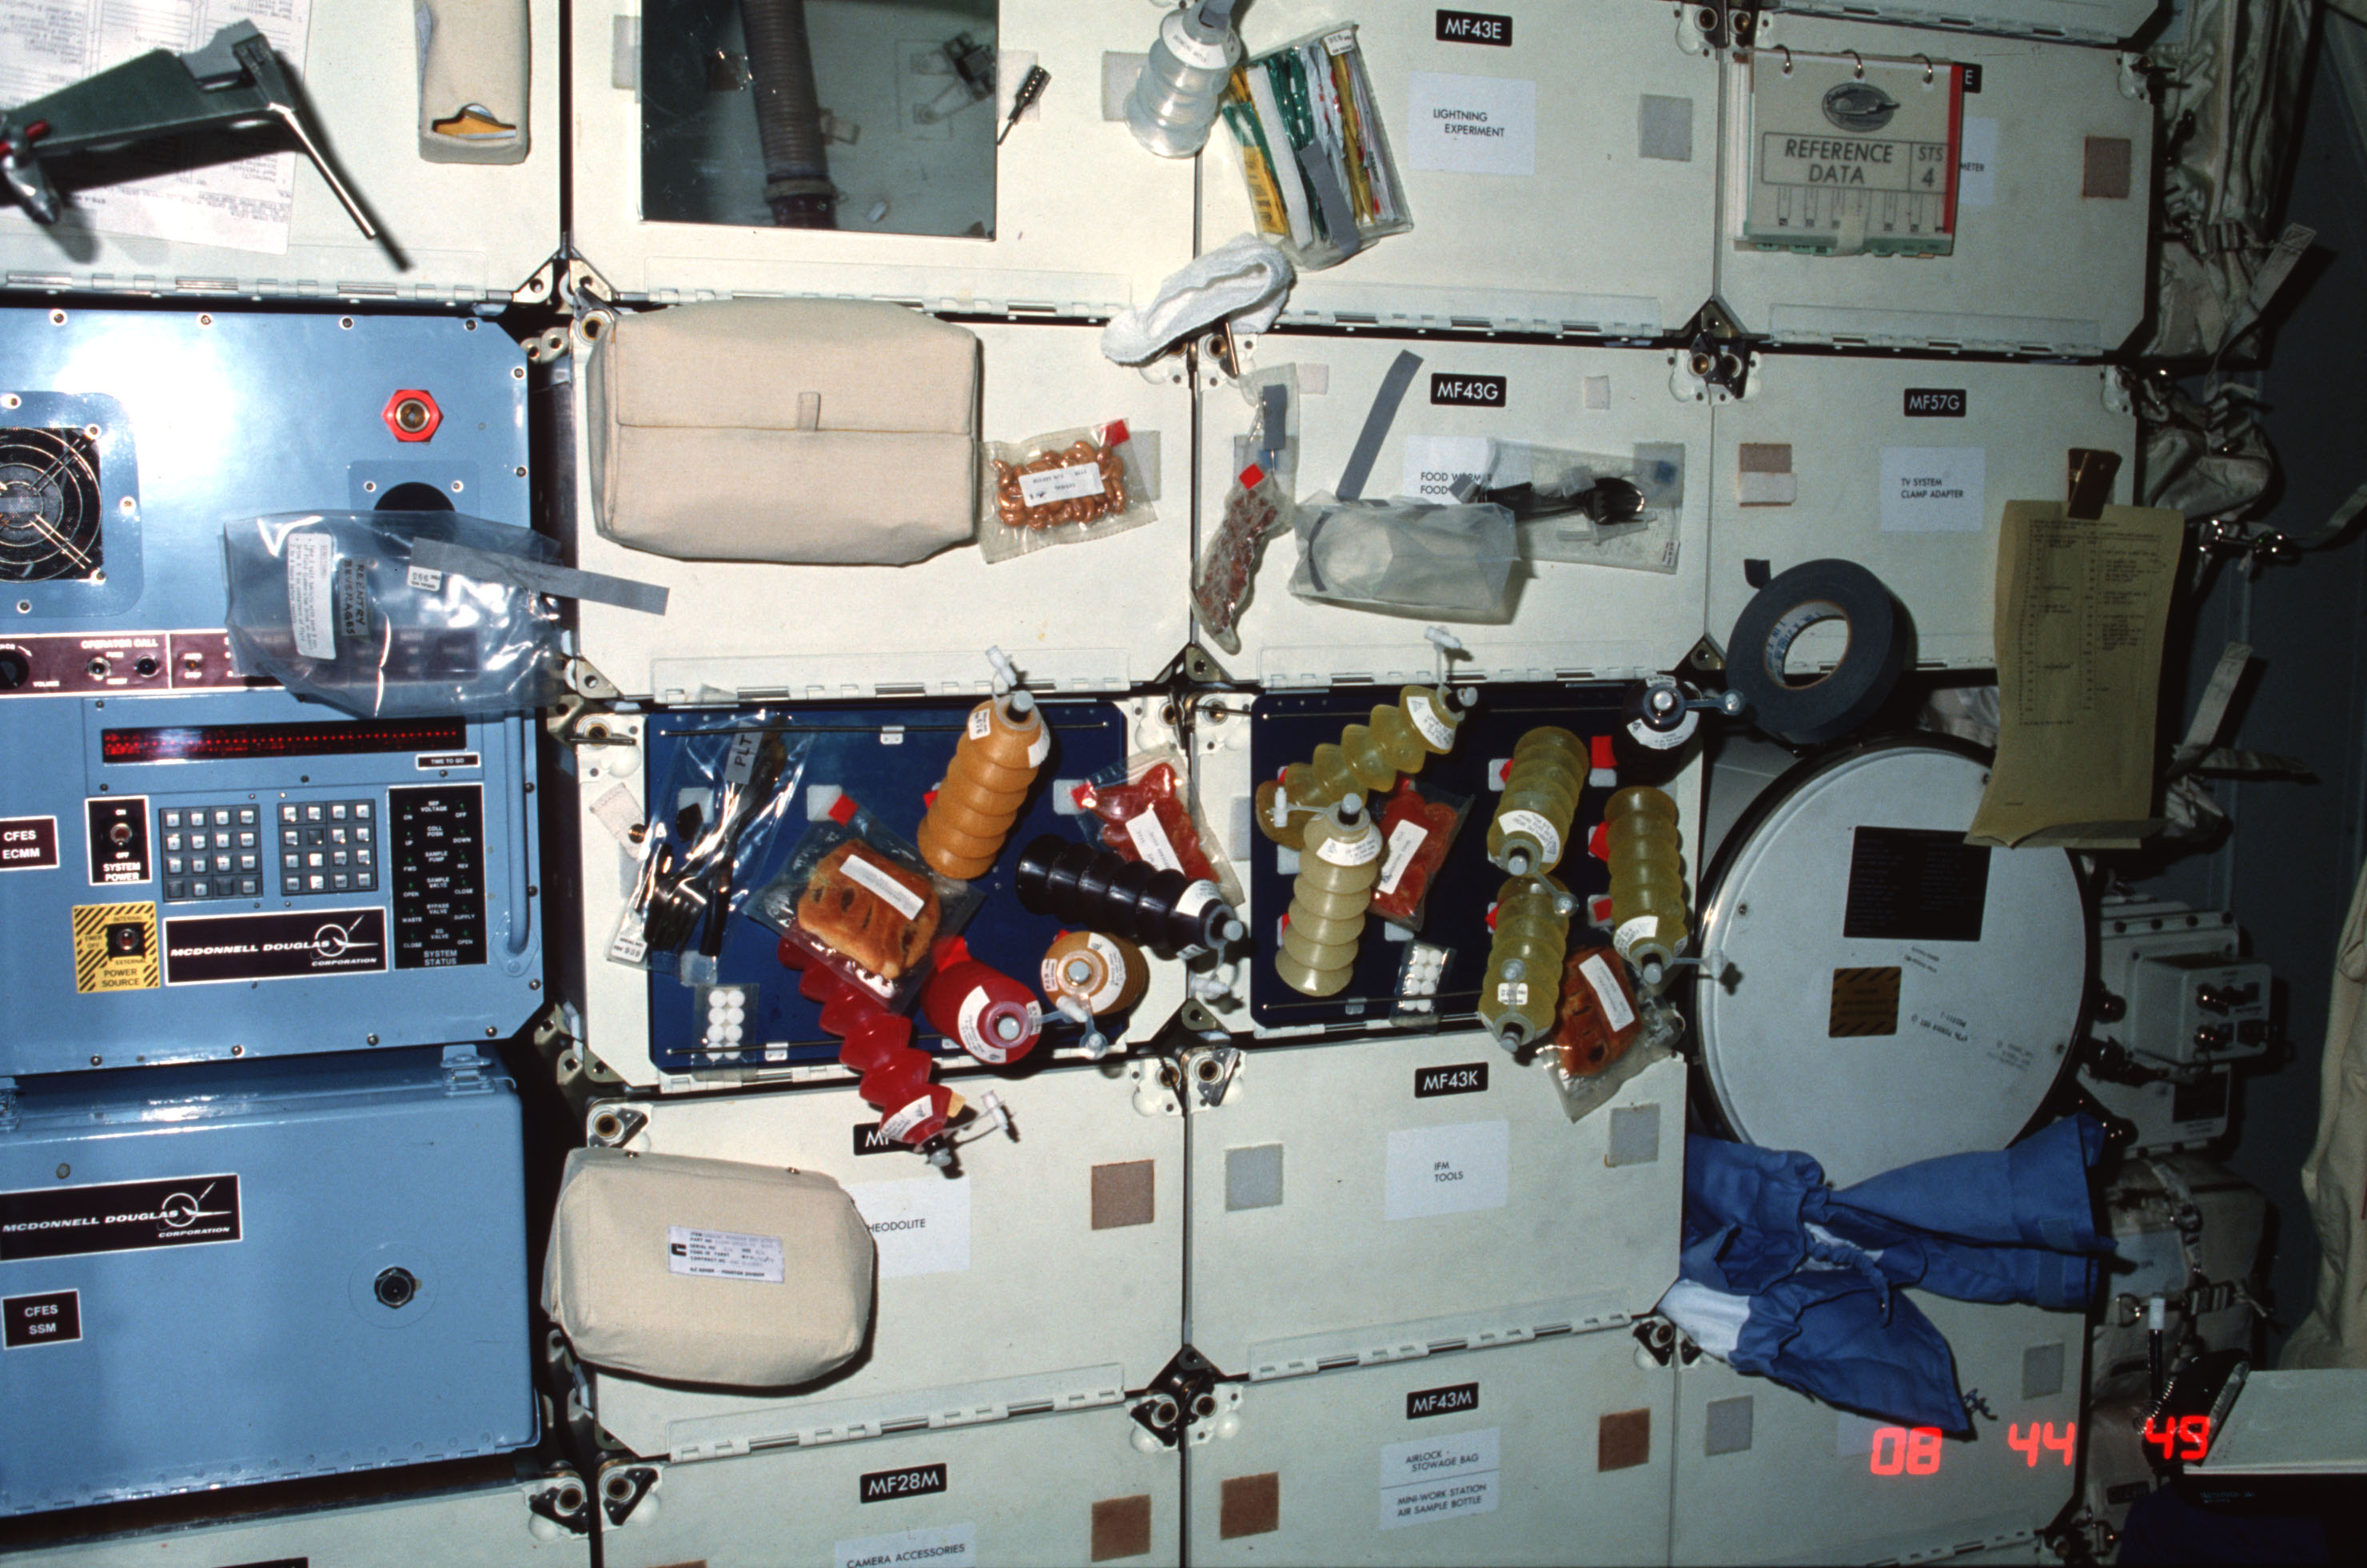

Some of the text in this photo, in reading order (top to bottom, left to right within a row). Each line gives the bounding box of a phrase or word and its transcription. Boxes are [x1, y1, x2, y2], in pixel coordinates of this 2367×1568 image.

[1445, 18, 1502, 40] MF43E
[1433, 108, 1488, 122] LIGHTNING
[1445, 123, 1505, 137] EXPERIMENT
[1784, 138, 1894, 164] REFERENCE
[1918, 145, 1944, 161] STS
[1807, 164, 1865, 185] DATA
[1959, 162, 1985, 173] METER
[1922, 166, 1935, 187] 4
[1437, 380, 1500, 400] MF43G
[1908, 394, 1960, 411] MF57G
[1421, 472, 1448, 481] FOOD
[1900, 477, 1943, 487] TV SYSTEM
[1420, 485, 1448, 495] FOOD
[1900, 489, 1964, 499] CLAMP ADAPTER
[344, 559, 356, 635] BEVERAGES
[355, 564, 365, 626] REENTRY
[81, 639, 158, 649] OPERATOR CALL
[735, 734, 752, 767] PLT
[3, 830, 38, 842] CFES
[2, 847, 41, 860] ECMM
[103, 862, 141, 872] SYSTEM
[105, 872, 140, 882] POWER
[170, 939, 330, 957] MCDONNELL DOUGLAS
[312, 957, 377, 967] CORPORATION
[104, 968, 137, 978] POWER
[102, 977, 140, 987] SOURCE
[1423, 1069, 1479, 1091] MF43K
[1434, 1161, 1450, 1171] IFM
[1434, 1171, 1464, 1183] TOOLS
[2, 1210, 179, 1233] MCDONNELL DOUGLAS
[867, 1219, 926, 1233] HEODOLITE
[158, 1227, 230, 1238] CORPORATION
[24, 1304, 58, 1318] CFES
[29, 1323, 57, 1335] SSM
[1413, 1390, 1472, 1414] MF43M
[1405, 1450, 1443, 1464] AIRLOCK
[1412, 1453, 1479, 1472] STOWAGE BAG
[868, 1470, 939, 1496] MF28M
[1397, 1483, 1487, 1506] MINI-WORK STATION
[1397, 1495, 1482, 1518] AIR SAMPLE BOTTLE
[846, 1544, 966, 1568] CAMERA ACCESSORIES
